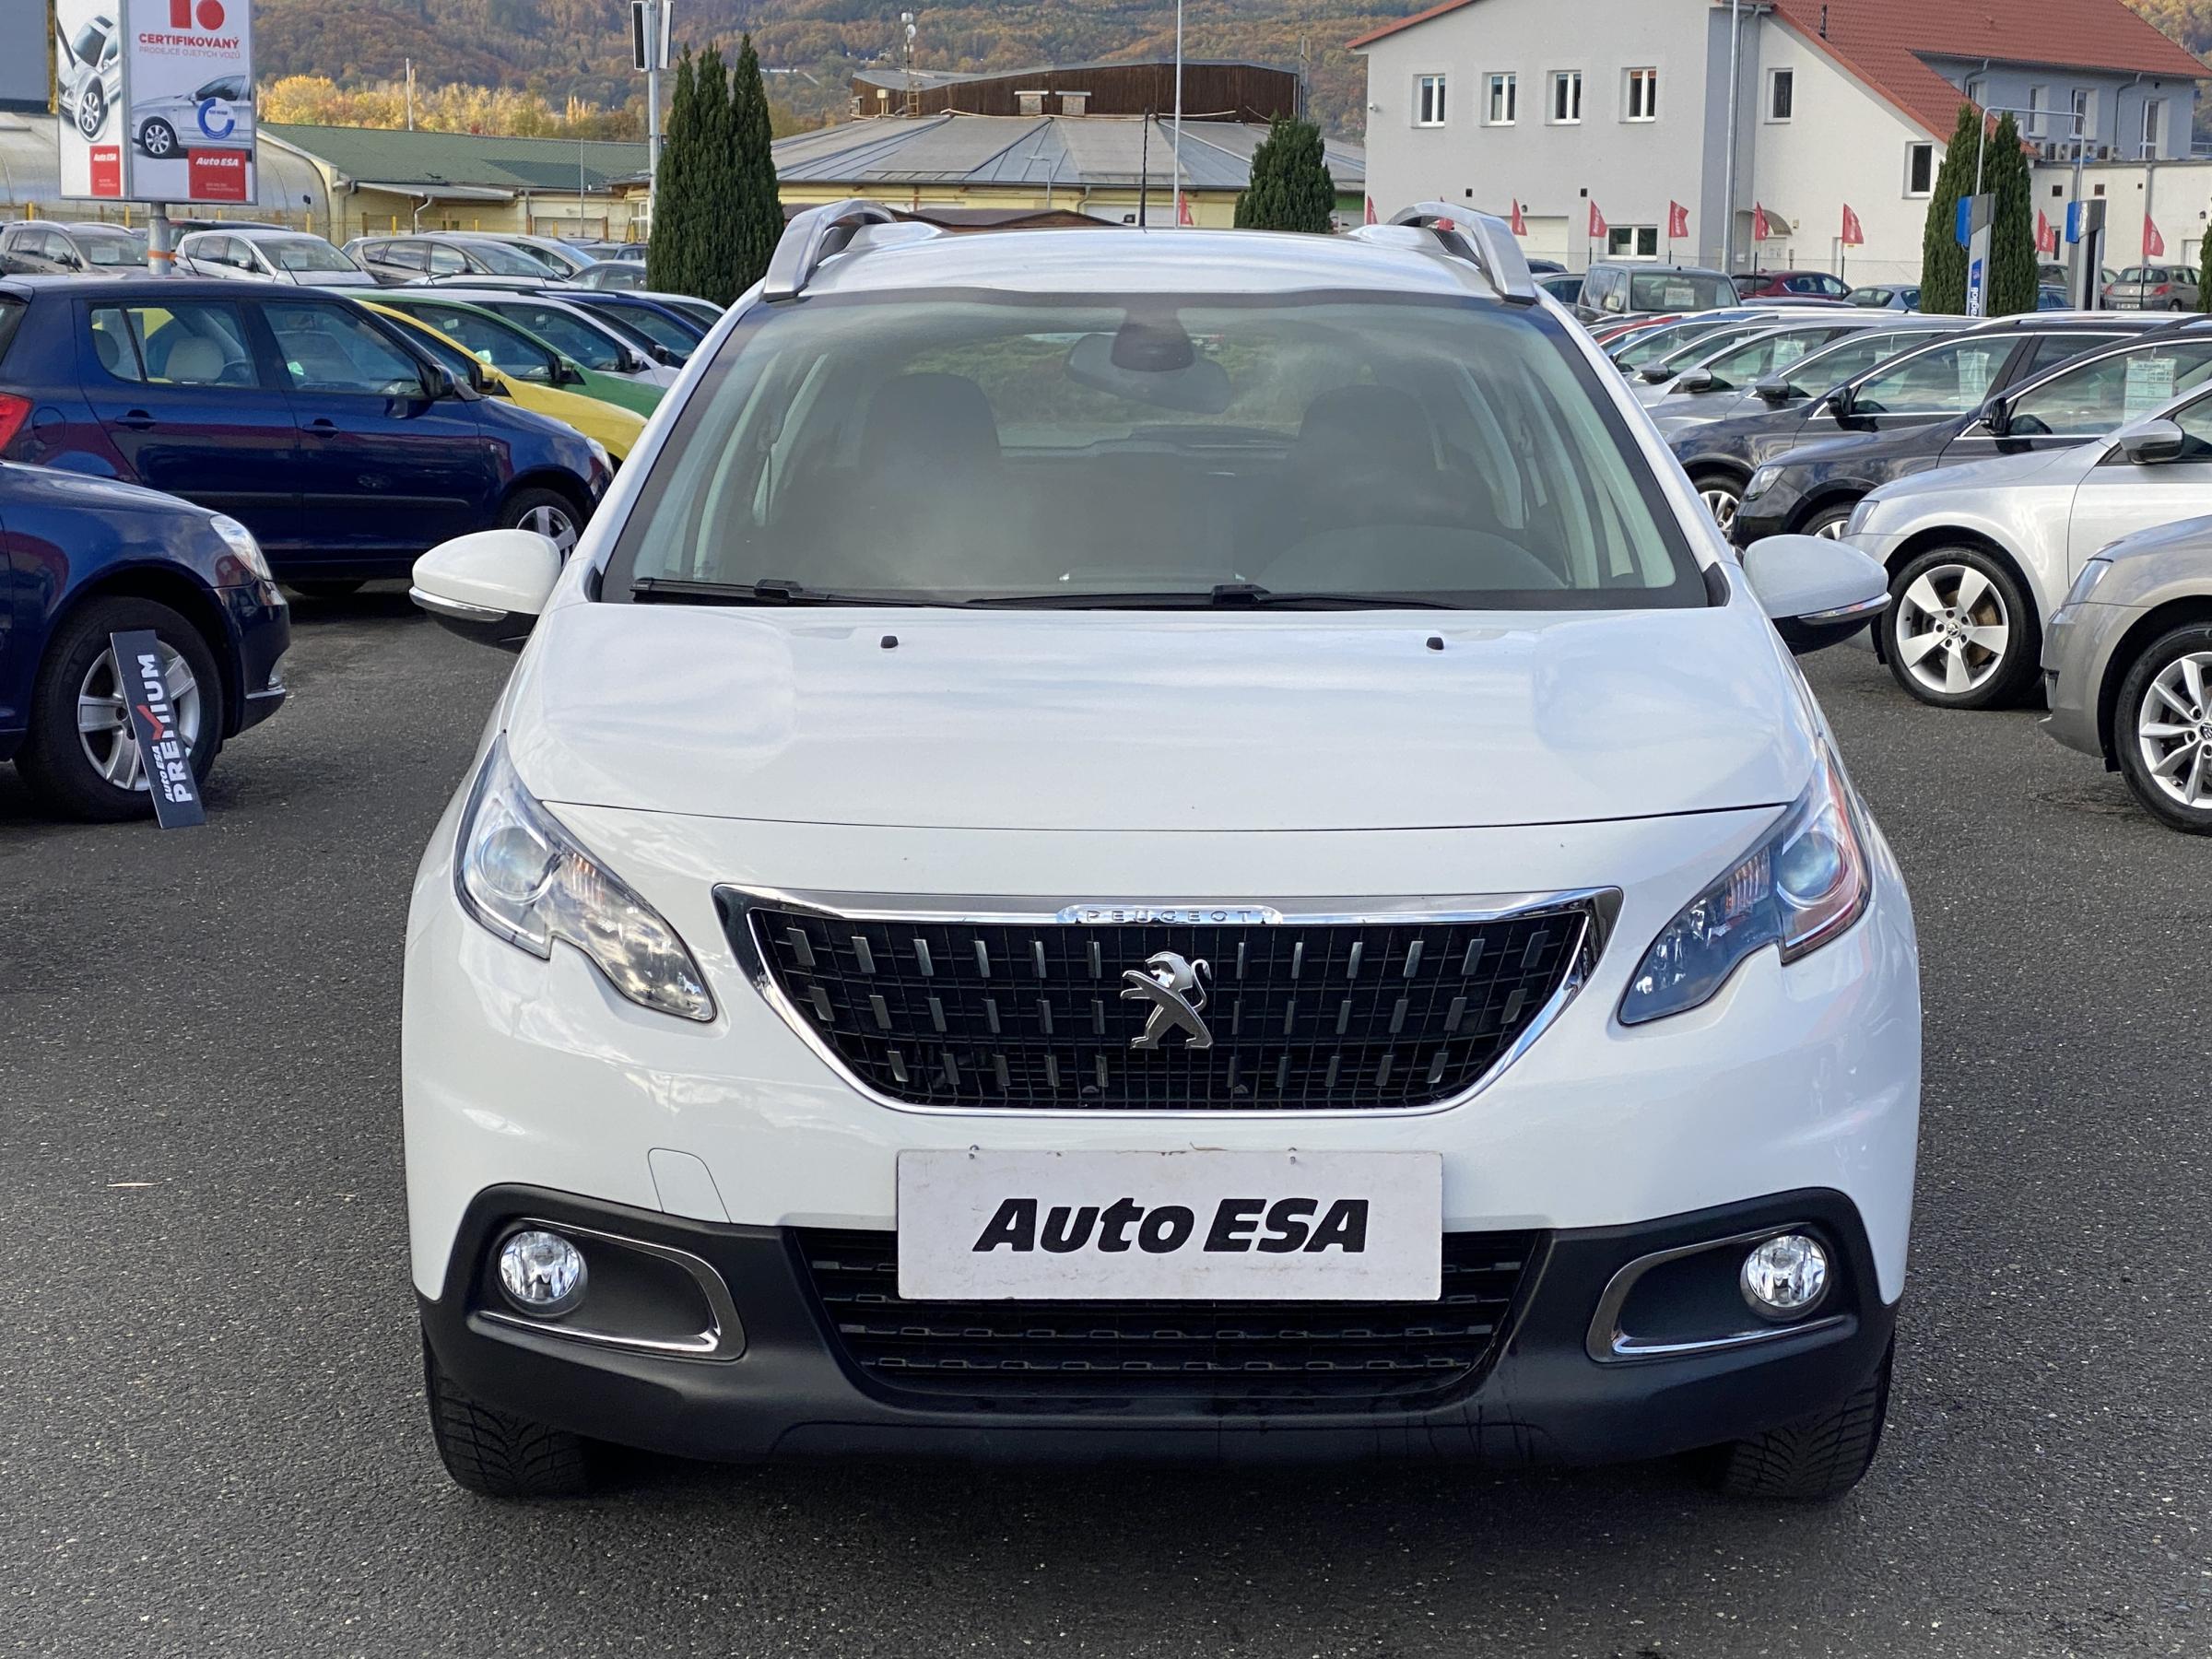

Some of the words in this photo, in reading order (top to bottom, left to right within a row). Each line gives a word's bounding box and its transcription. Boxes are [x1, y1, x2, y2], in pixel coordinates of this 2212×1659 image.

[139, 33, 240, 49] CERTIFIKOVANÝ
[196, 157, 219, 166] Auto
[220, 158, 240, 167] ESA
[136, 654, 193, 802] PREMIUM
[151, 746, 165, 770] ESA
[1086, 911, 1252, 922] PEUGEOT
[972, 1197, 1195, 1253] Auto
[1203, 1198, 1370, 1253] ESA
